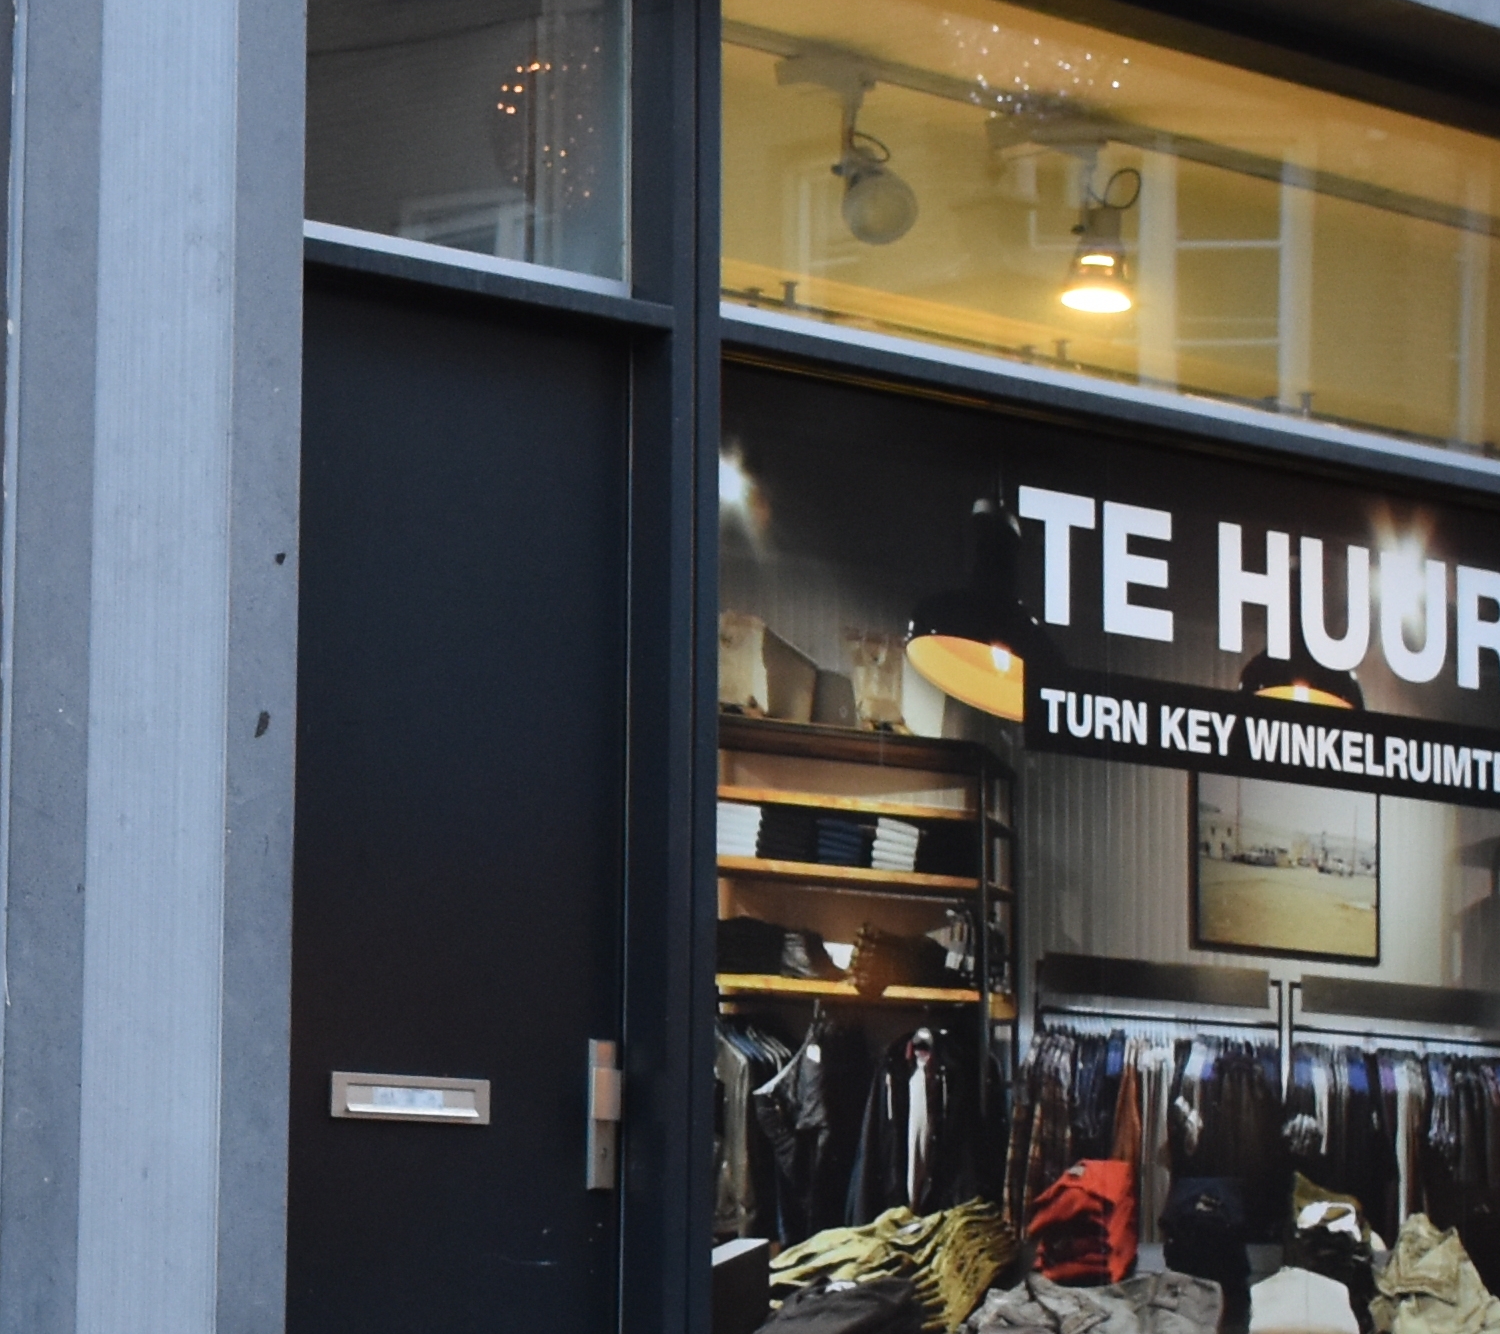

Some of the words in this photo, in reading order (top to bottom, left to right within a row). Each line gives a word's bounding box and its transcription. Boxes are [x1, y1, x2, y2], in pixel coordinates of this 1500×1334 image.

[1019, 485, 1174, 643] TE
[1040, 687, 1149, 746] TURN
[1160, 704, 1237, 757] KEY
